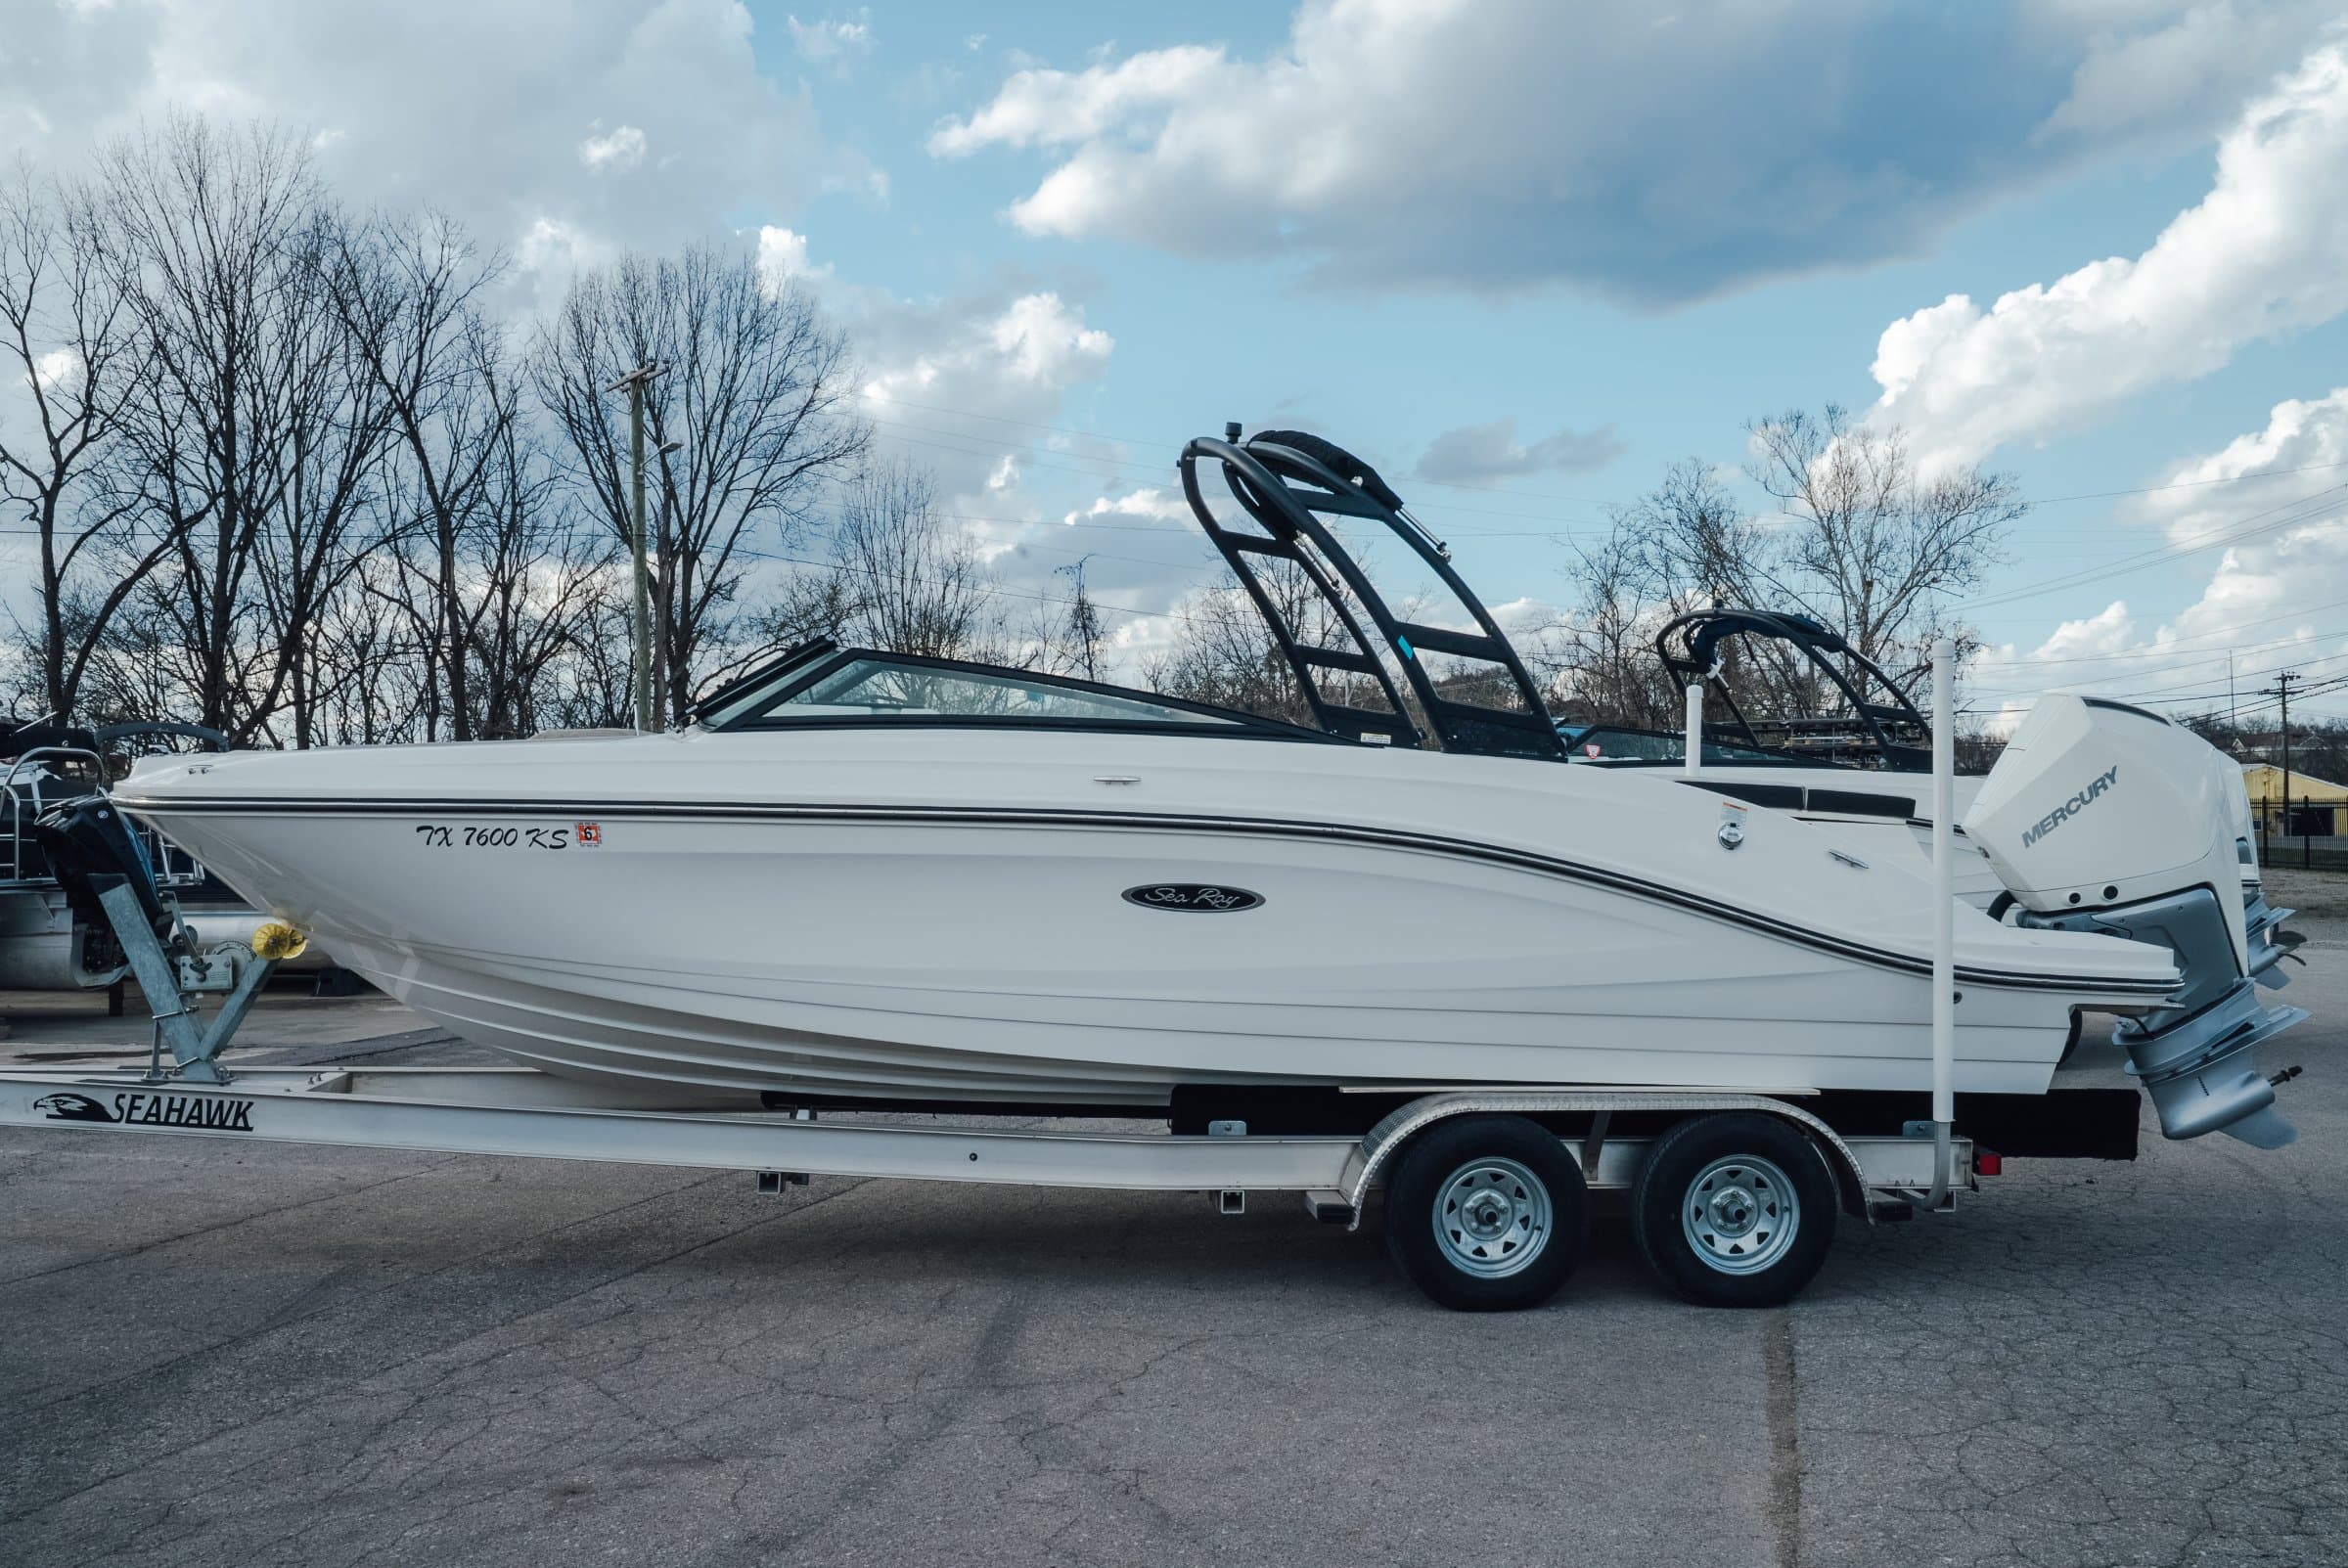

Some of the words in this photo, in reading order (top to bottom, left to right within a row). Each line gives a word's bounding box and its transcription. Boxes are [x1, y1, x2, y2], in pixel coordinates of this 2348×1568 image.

[2021, 765, 2117, 849] MERCURY
[416, 825, 453, 847] TX
[463, 827, 519, 847] 7600
[525, 828, 569, 849] KS
[1145, 887, 1190, 904] Sea
[1193, 887, 1241, 909] Ray
[114, 1093, 254, 1132] SEAHAWK
